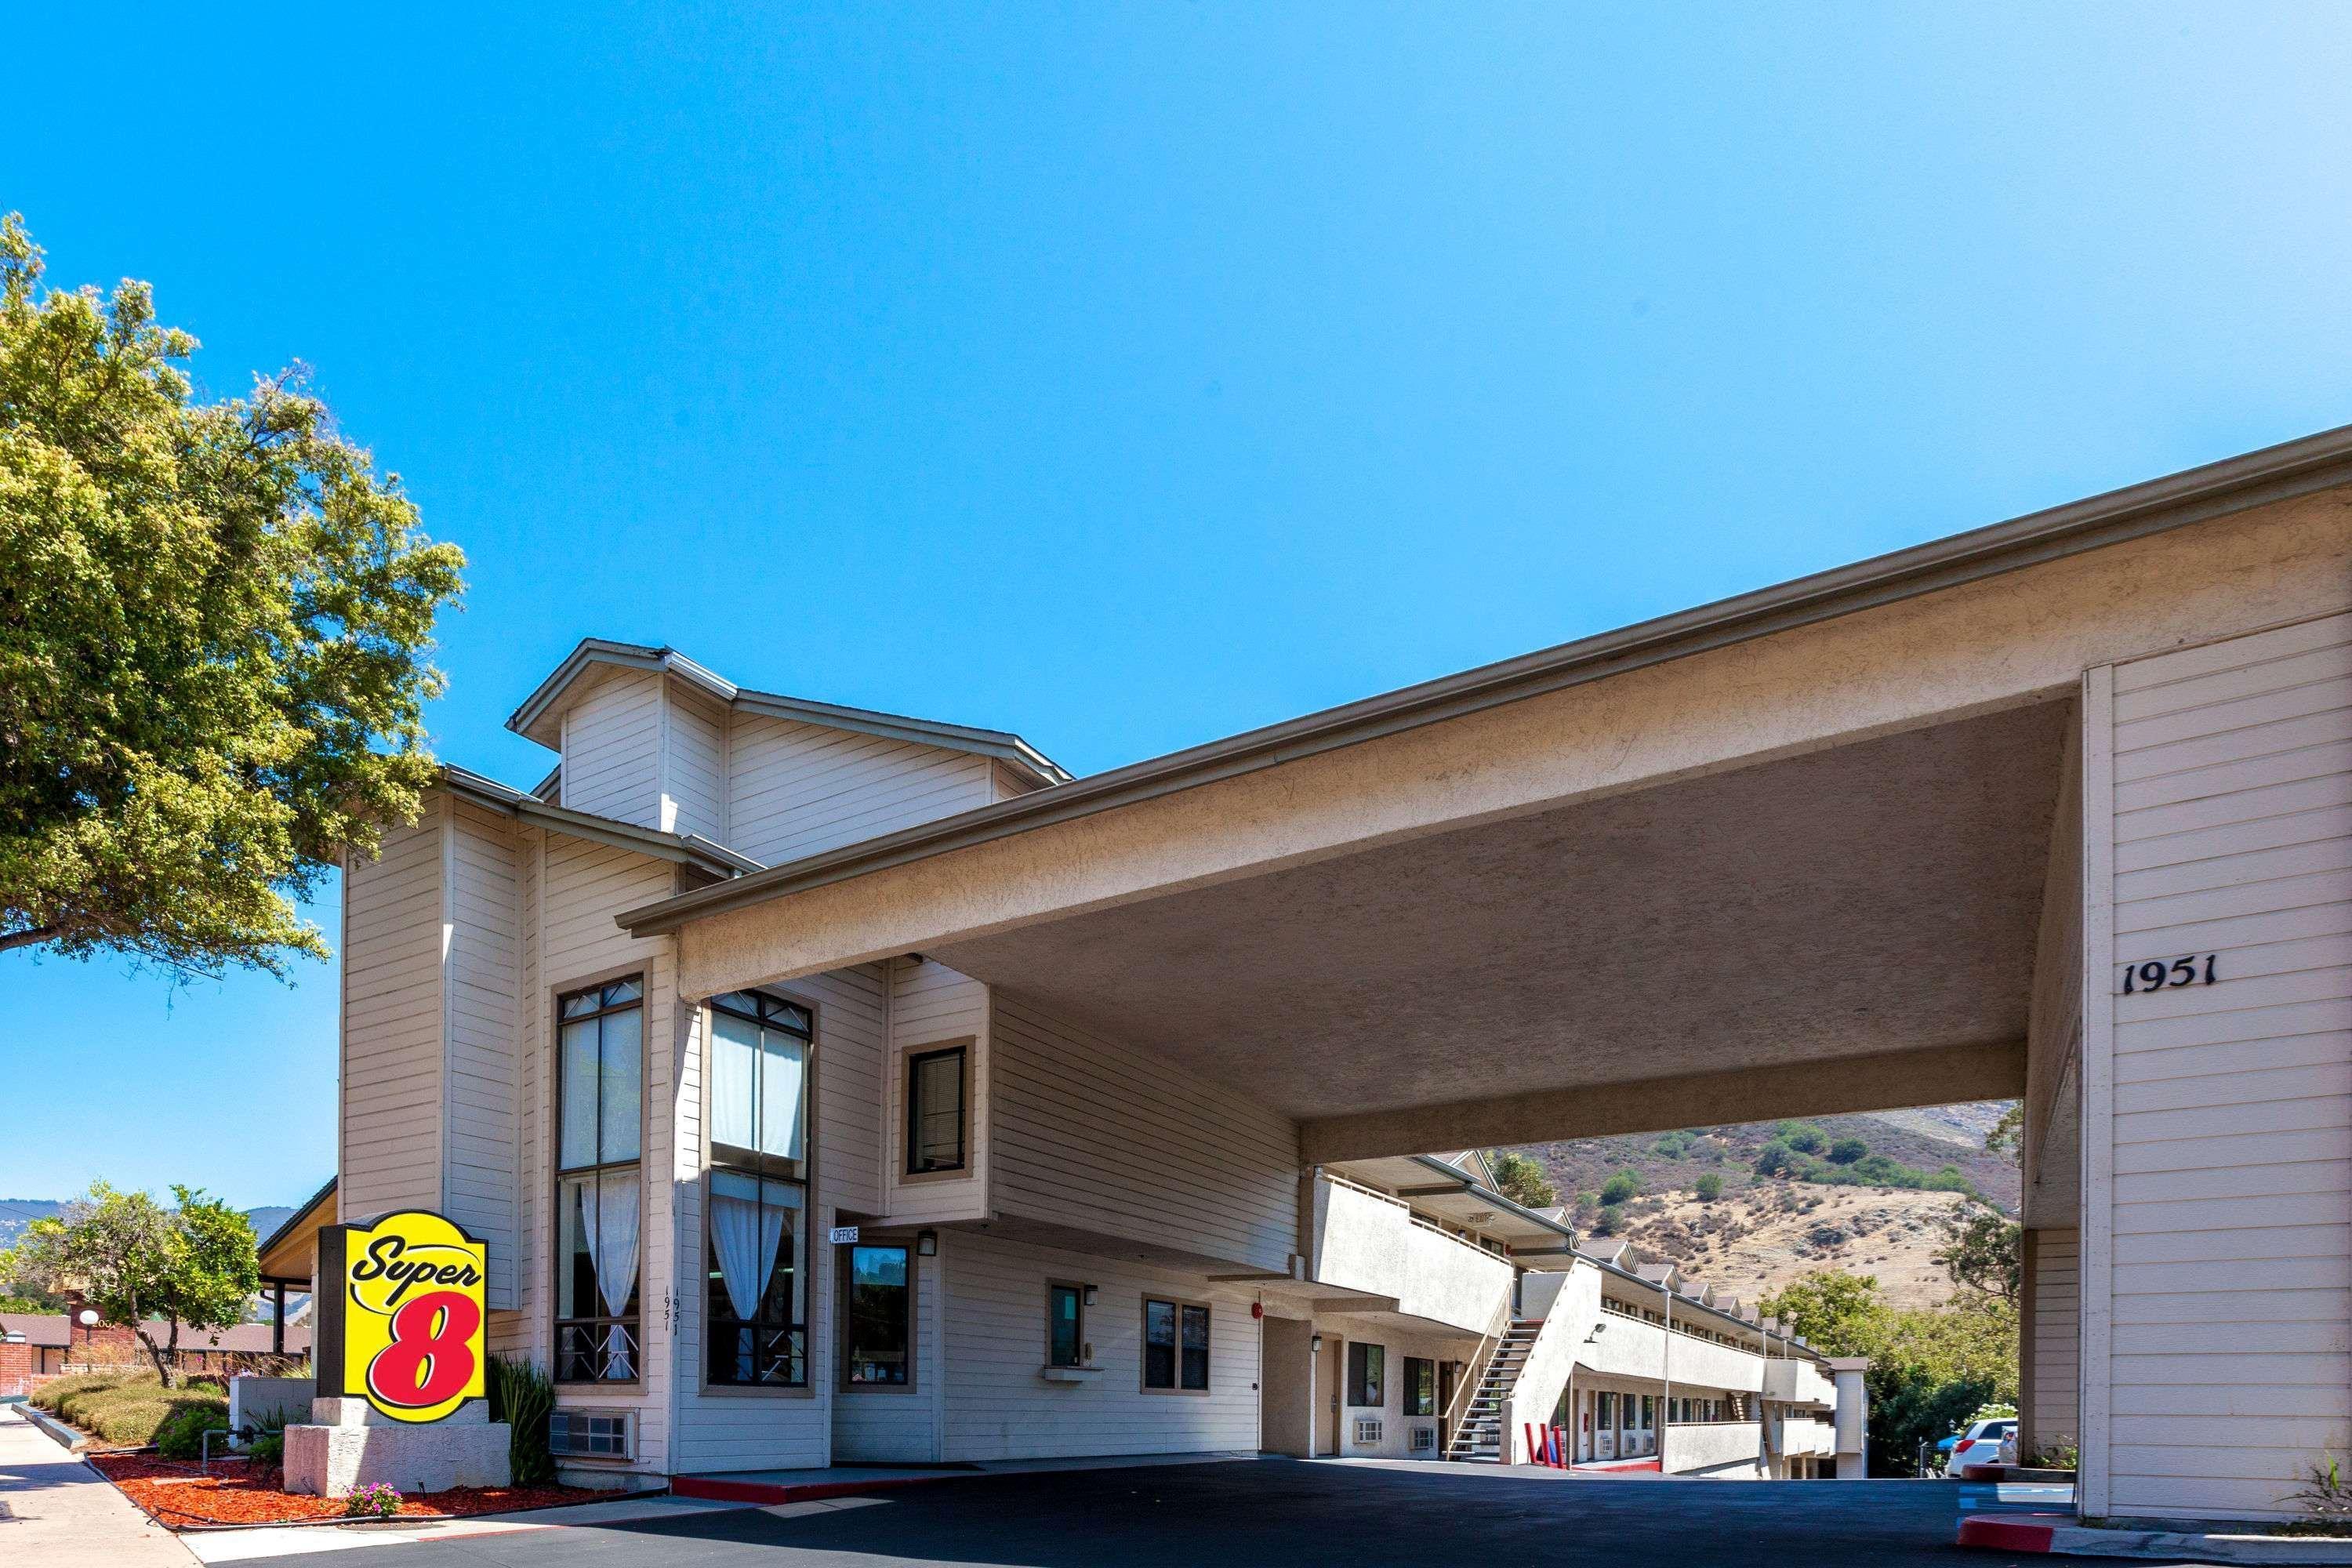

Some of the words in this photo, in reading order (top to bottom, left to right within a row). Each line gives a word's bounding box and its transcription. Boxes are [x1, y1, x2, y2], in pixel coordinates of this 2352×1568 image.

[2124, 954, 2216, 995] 1951
[833, 1228, 857, 1242] OFFICE
[352, 1235, 481, 1307] Super
[365, 1291, 481, 1409] 8
